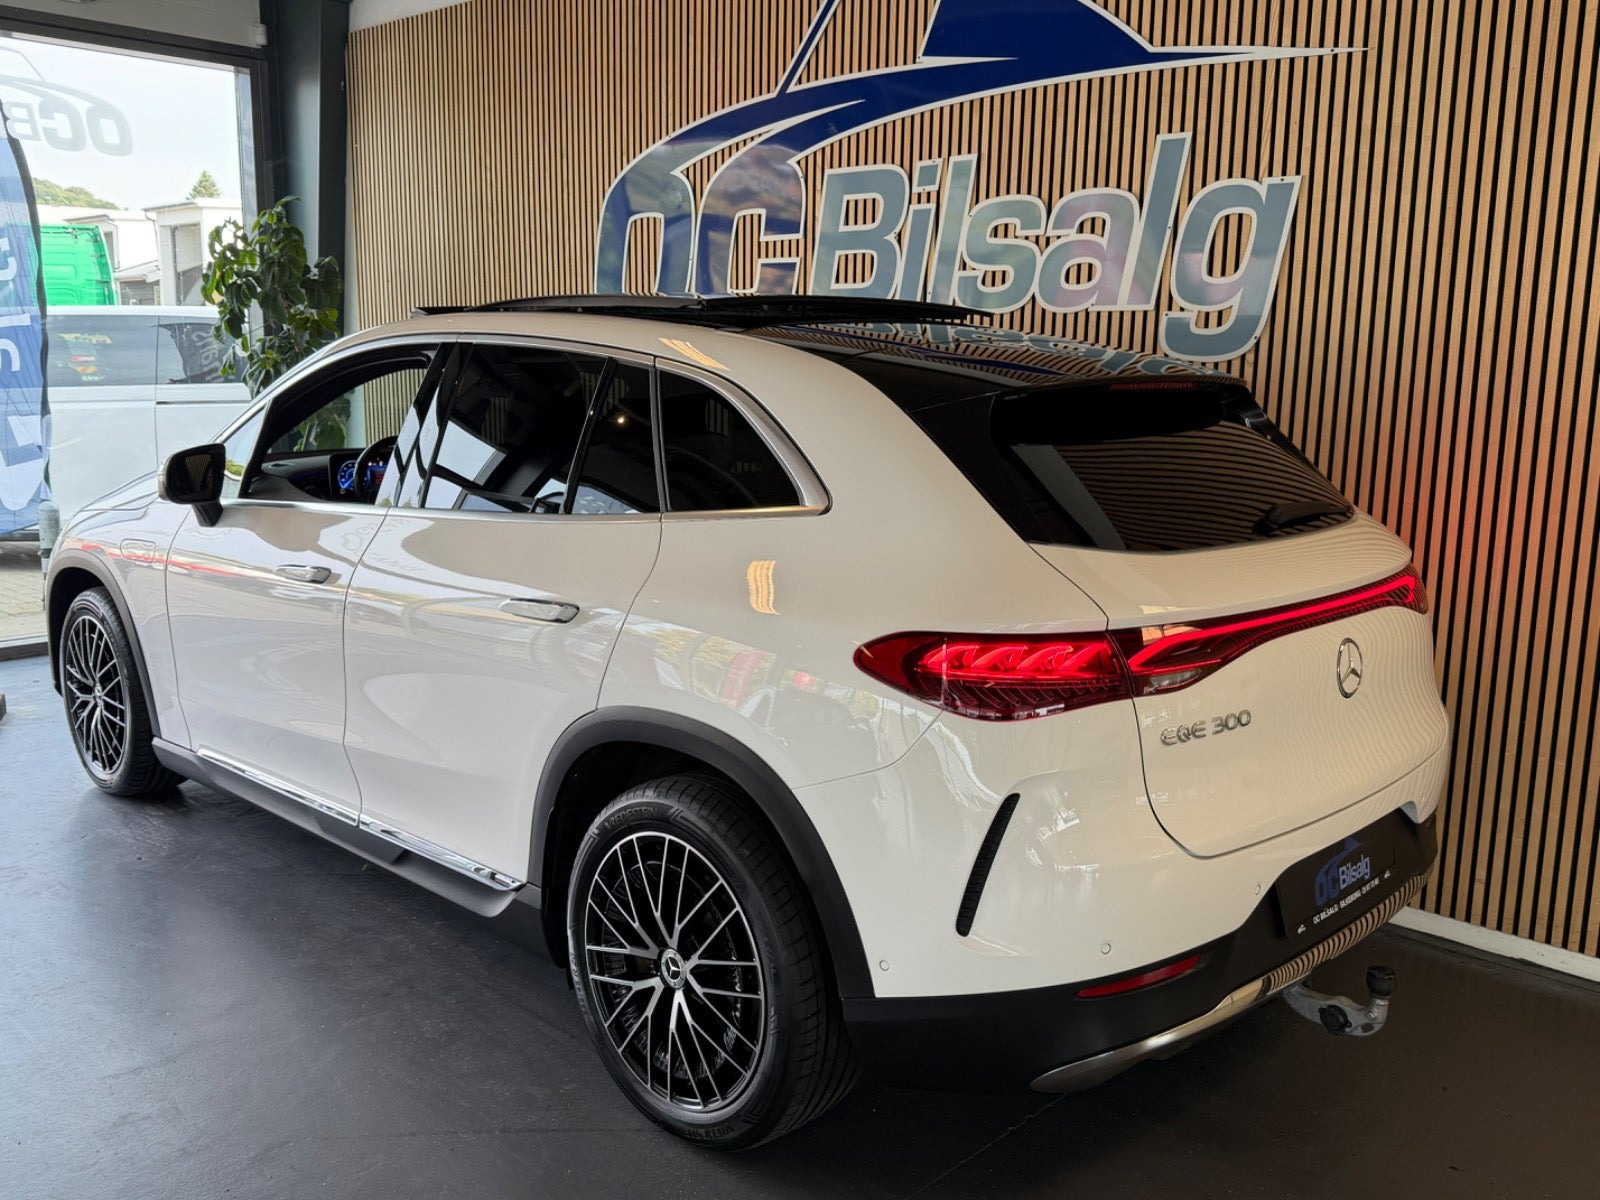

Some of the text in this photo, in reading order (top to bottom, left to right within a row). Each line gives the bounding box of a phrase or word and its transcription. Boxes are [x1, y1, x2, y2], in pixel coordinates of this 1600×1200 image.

[808, 131, 1302, 363] Bilsalg
[1160, 709, 1252, 746] EQE 300
[1338, 853, 1371, 890] Bilsalg
